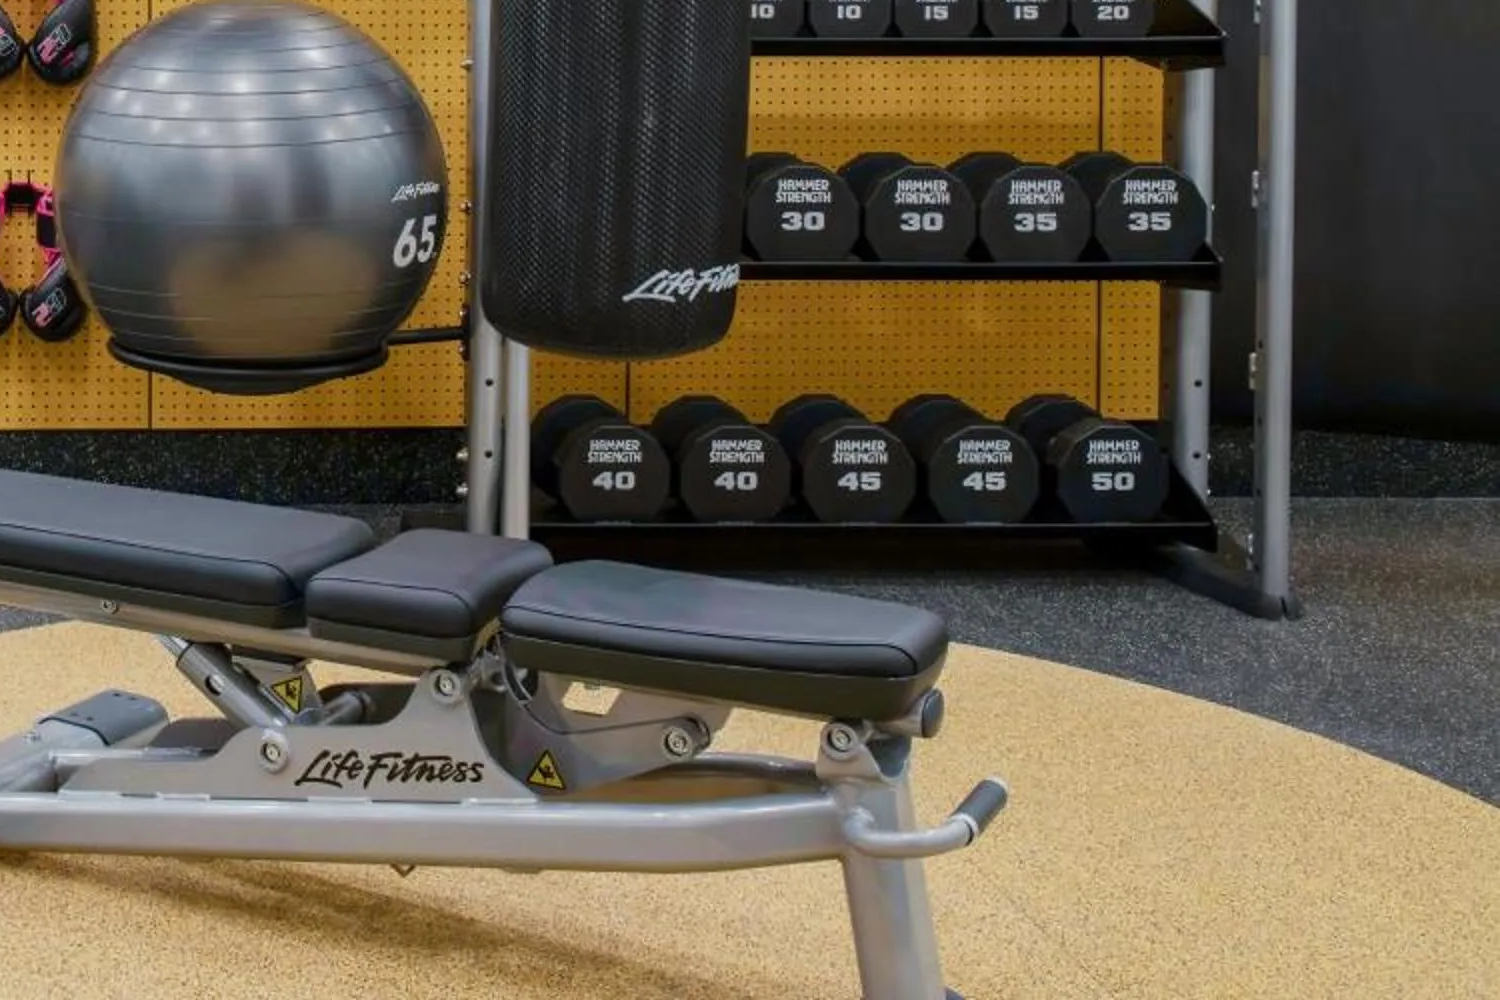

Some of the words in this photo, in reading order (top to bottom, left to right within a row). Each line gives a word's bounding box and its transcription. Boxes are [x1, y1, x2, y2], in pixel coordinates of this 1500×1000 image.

[751, 3, 775, 19] 10
[837, 5, 862, 20] 10
[924, 5, 949, 20] 15
[1014, 5, 1039, 20] 15
[1097, 5, 1129, 20] 20
[778, 179, 829, 191] HAMMER
[897, 179, 948, 191] HAMMER
[1010, 179, 1062, 191] HAMMER
[1125, 179, 1177, 191] HAMMER
[775, 192, 831, 204] STRENGTH
[894, 192, 950, 204] STRENGTH
[1008, 192, 1064, 204] STRENGTH
[1122, 192, 1179, 204] STRENGTH
[781, 211, 825, 231] 30
[900, 211, 944, 231] 30
[1014, 211, 1057, 231] 35
[1128, 211, 1171, 231] 35
[393, 214, 437, 268] 65
[589, 439, 641, 451] HAMMER
[711, 439, 763, 451] HAMMER
[834, 439, 886, 451] HAMMER
[959, 439, 1011, 451] HAMMER
[1089, 439, 1140, 451] HAMMER
[587, 451, 642, 464] STRENGTH
[709, 451, 764, 464] STRENGTH
[832, 451, 888, 464] STRENGTH
[957, 451, 1013, 464] STRENGTH
[1086, 451, 1141, 464] STRENGTH
[592, 471, 636, 491] 40
[714, 471, 758, 491] 40
[837, 471, 882, 491] 45
[963, 471, 1007, 491] 45
[1091, 471, 1135, 491] 50
